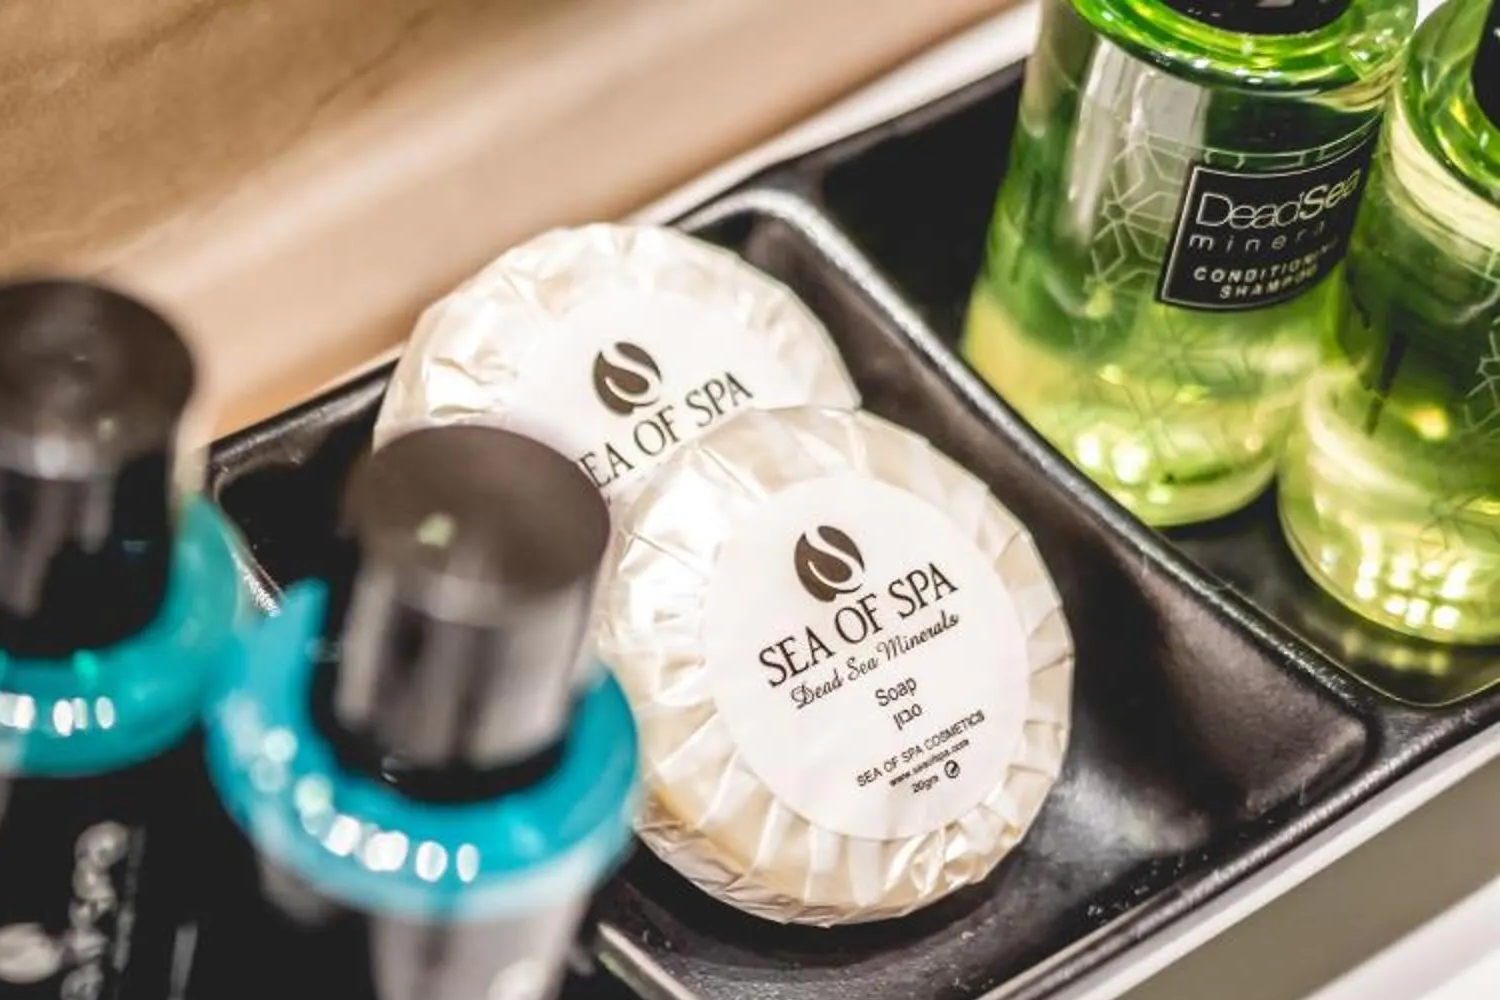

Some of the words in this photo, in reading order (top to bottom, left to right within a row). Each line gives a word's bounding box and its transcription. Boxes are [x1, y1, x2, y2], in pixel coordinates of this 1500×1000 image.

[577, 442, 635, 489] EA
[633, 404, 680, 457] OF
[684, 371, 754, 428] SPA
[758, 626, 835, 688] SEA
[834, 592, 883, 645] OF
[888, 562, 959, 620] SPA
[790, 668, 845, 710] Dead
[846, 655, 880, 682] Sea
[875, 609, 960, 662] Minerals
[874, 676, 918, 707] Soap
[856, 767, 883, 788] SEA
[883, 755, 899, 773] OF
[901, 744, 924, 763] SPA
[923, 709, 986, 751] COSMETICS
